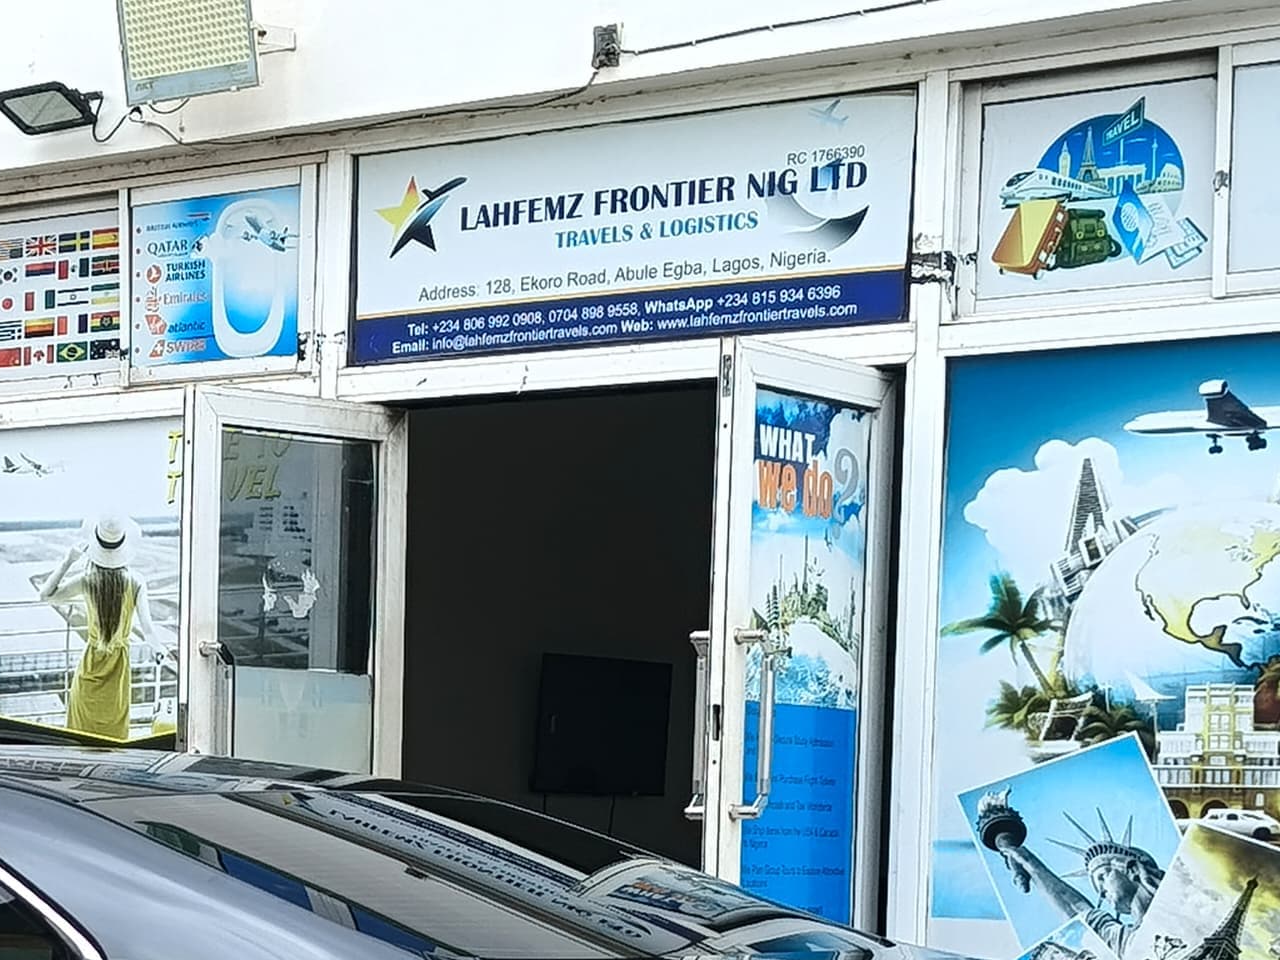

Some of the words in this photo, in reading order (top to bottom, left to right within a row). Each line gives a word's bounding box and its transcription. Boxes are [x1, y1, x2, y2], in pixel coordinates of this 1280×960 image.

[1106, 110, 1139, 141] TRAVEL
[787, 152, 807, 165] RC
[812, 145, 865, 162] 1766390
[461, 193, 583, 231] LAHFEMZ
[594, 176, 735, 216] FRONTIER
[747, 168, 798, 200] NIG
[810, 161, 867, 193] LTD
[147, 239, 188, 256] QATAR
[555, 224, 633, 249] TRAVELS
[639, 223, 653, 240] &
[659, 210, 759, 238] LOGISTICS
[165, 269, 206, 282] AIRLINES
[166, 259, 206, 272] TURKISH
[419, 286, 480, 301] Address:
[486, 278, 515, 295] 128,
[521, 275, 562, 292] Ekoro
[568, 269, 610, 287] Road,
[615, 265, 658, 282] Abule
[663, 261, 706, 280] Egba,
[712, 257, 764, 275] Lagos,
[770, 249, 831, 271] Nigeria.
[408, 323, 428, 336] Tel:
[432, 319, 459, 333] +234
[463, 317, 485, 331] 806
[489, 315, 510, 328] 992
[549, 309, 577, 323] 0704
[581, 306, 604, 320] 898
[644, 297, 713, 315] WhatsApp
[717, 292, 748, 308] +234
[752, 289, 777, 305] 815
[780, 286, 804, 302] 934
[808, 285, 841, 300] 6396
[392, 340, 429, 354] Email:
[620, 317, 654, 333] Web:
[760, 424, 815, 464] WHAT
[758, 460, 796, 513] we
[803, 459, 833, 519] do
